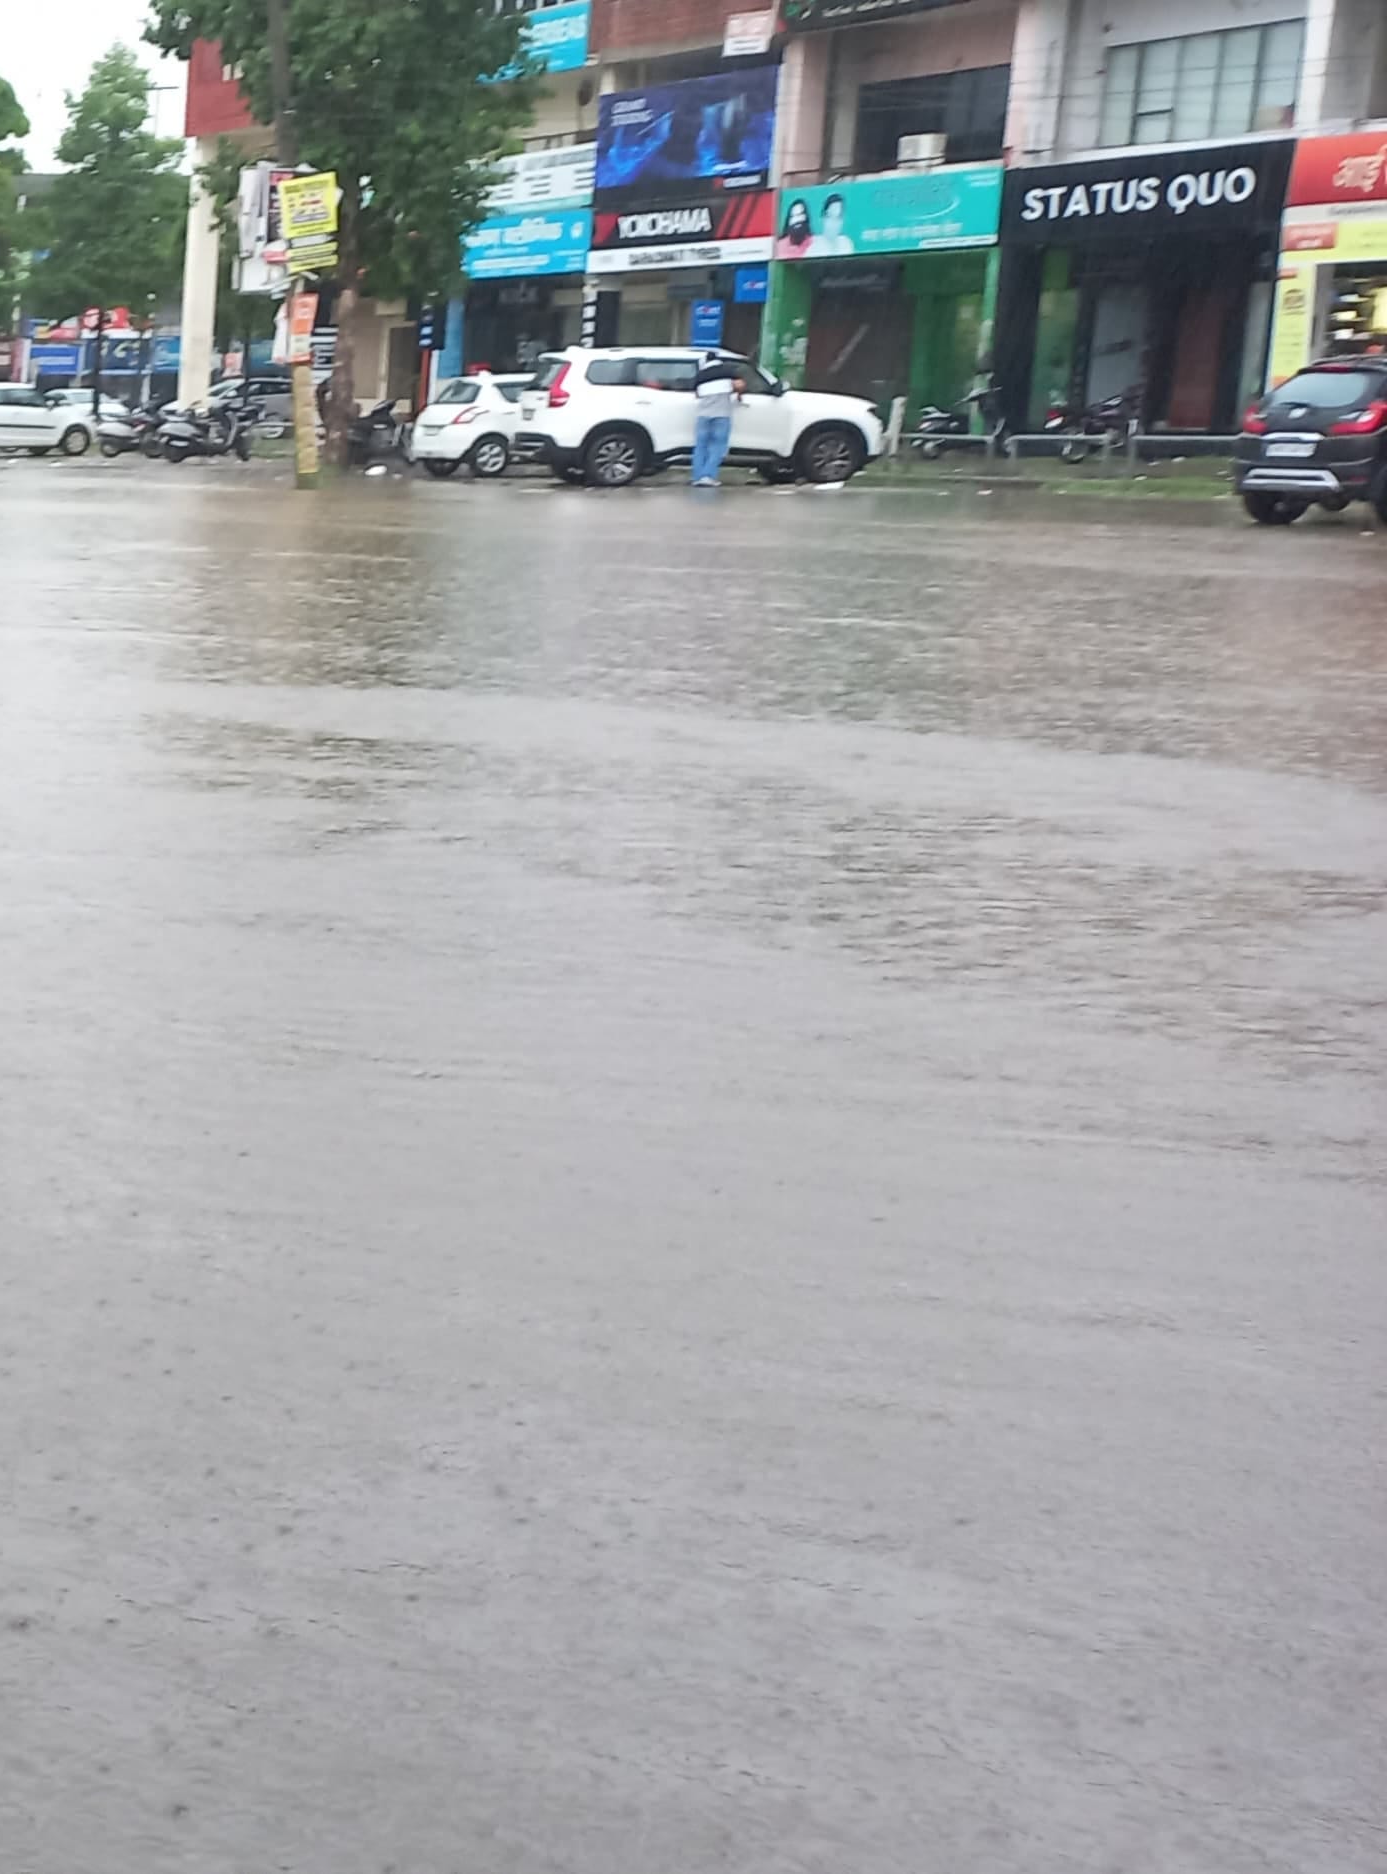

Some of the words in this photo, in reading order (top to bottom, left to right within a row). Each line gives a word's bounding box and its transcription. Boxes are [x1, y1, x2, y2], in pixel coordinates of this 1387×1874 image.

[1021, 176, 1161, 220] STATUS
[1166, 167, 1257, 214] QUO
[617, 207, 712, 240] YOKOHAMA
